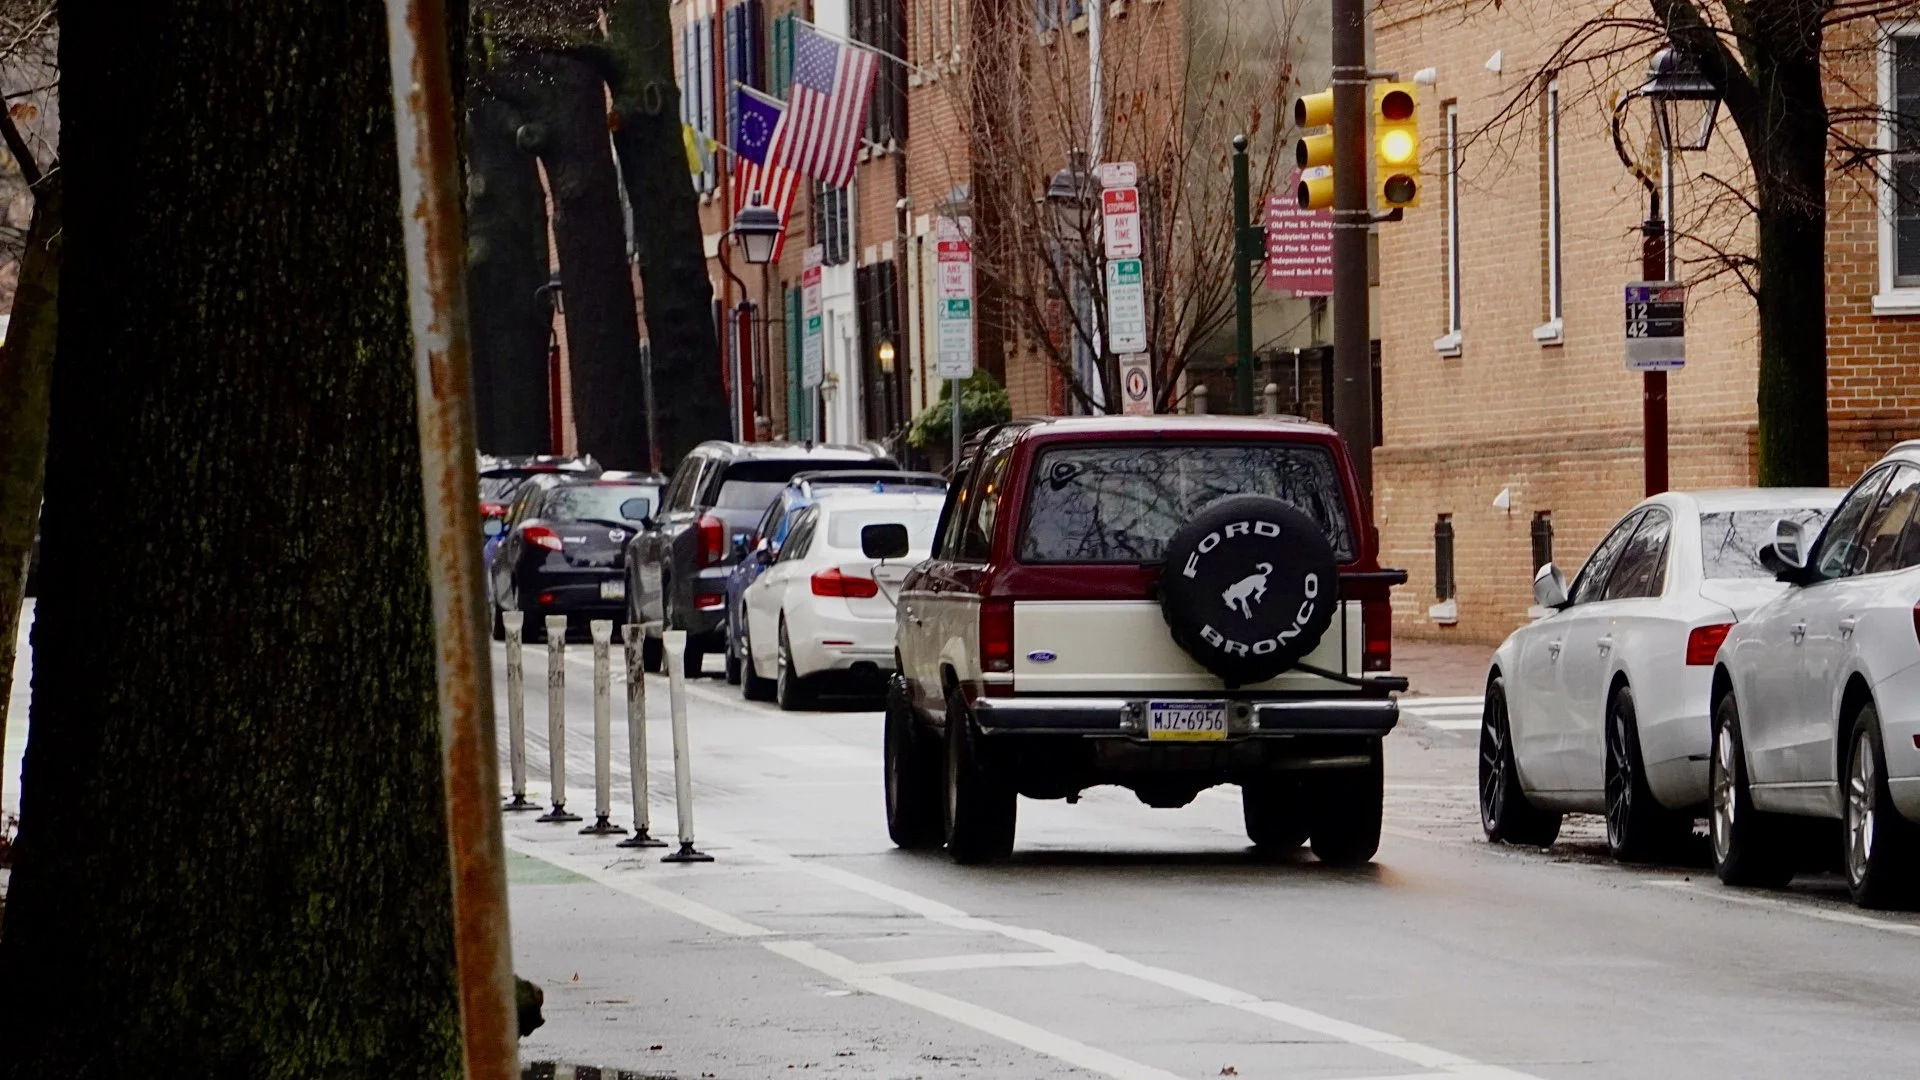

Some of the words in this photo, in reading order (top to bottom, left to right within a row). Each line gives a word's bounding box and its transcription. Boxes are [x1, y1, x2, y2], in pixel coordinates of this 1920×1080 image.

[1271, 197, 1294, 205] Society
[1271, 209, 1295, 217] Physick
[1114, 217, 1129, 227] ANY
[1115, 229, 1130, 240] TIME
[1271, 232, 1310, 241] Presbyterian
[1300, 244, 1309, 252] St.
[1271, 257, 1315, 265] Independence
[947, 265, 961, 273] ANY
[1296, 268, 1312, 276] Bank
[1110, 266, 1116, 283] 2
[947, 275, 962, 285] TIME
[1628, 303, 1648, 319] 12
[1628, 321, 1648, 337] 42
[1182, 520, 1281, 579] FORD
[1199, 572, 1318, 658] BRONCO
